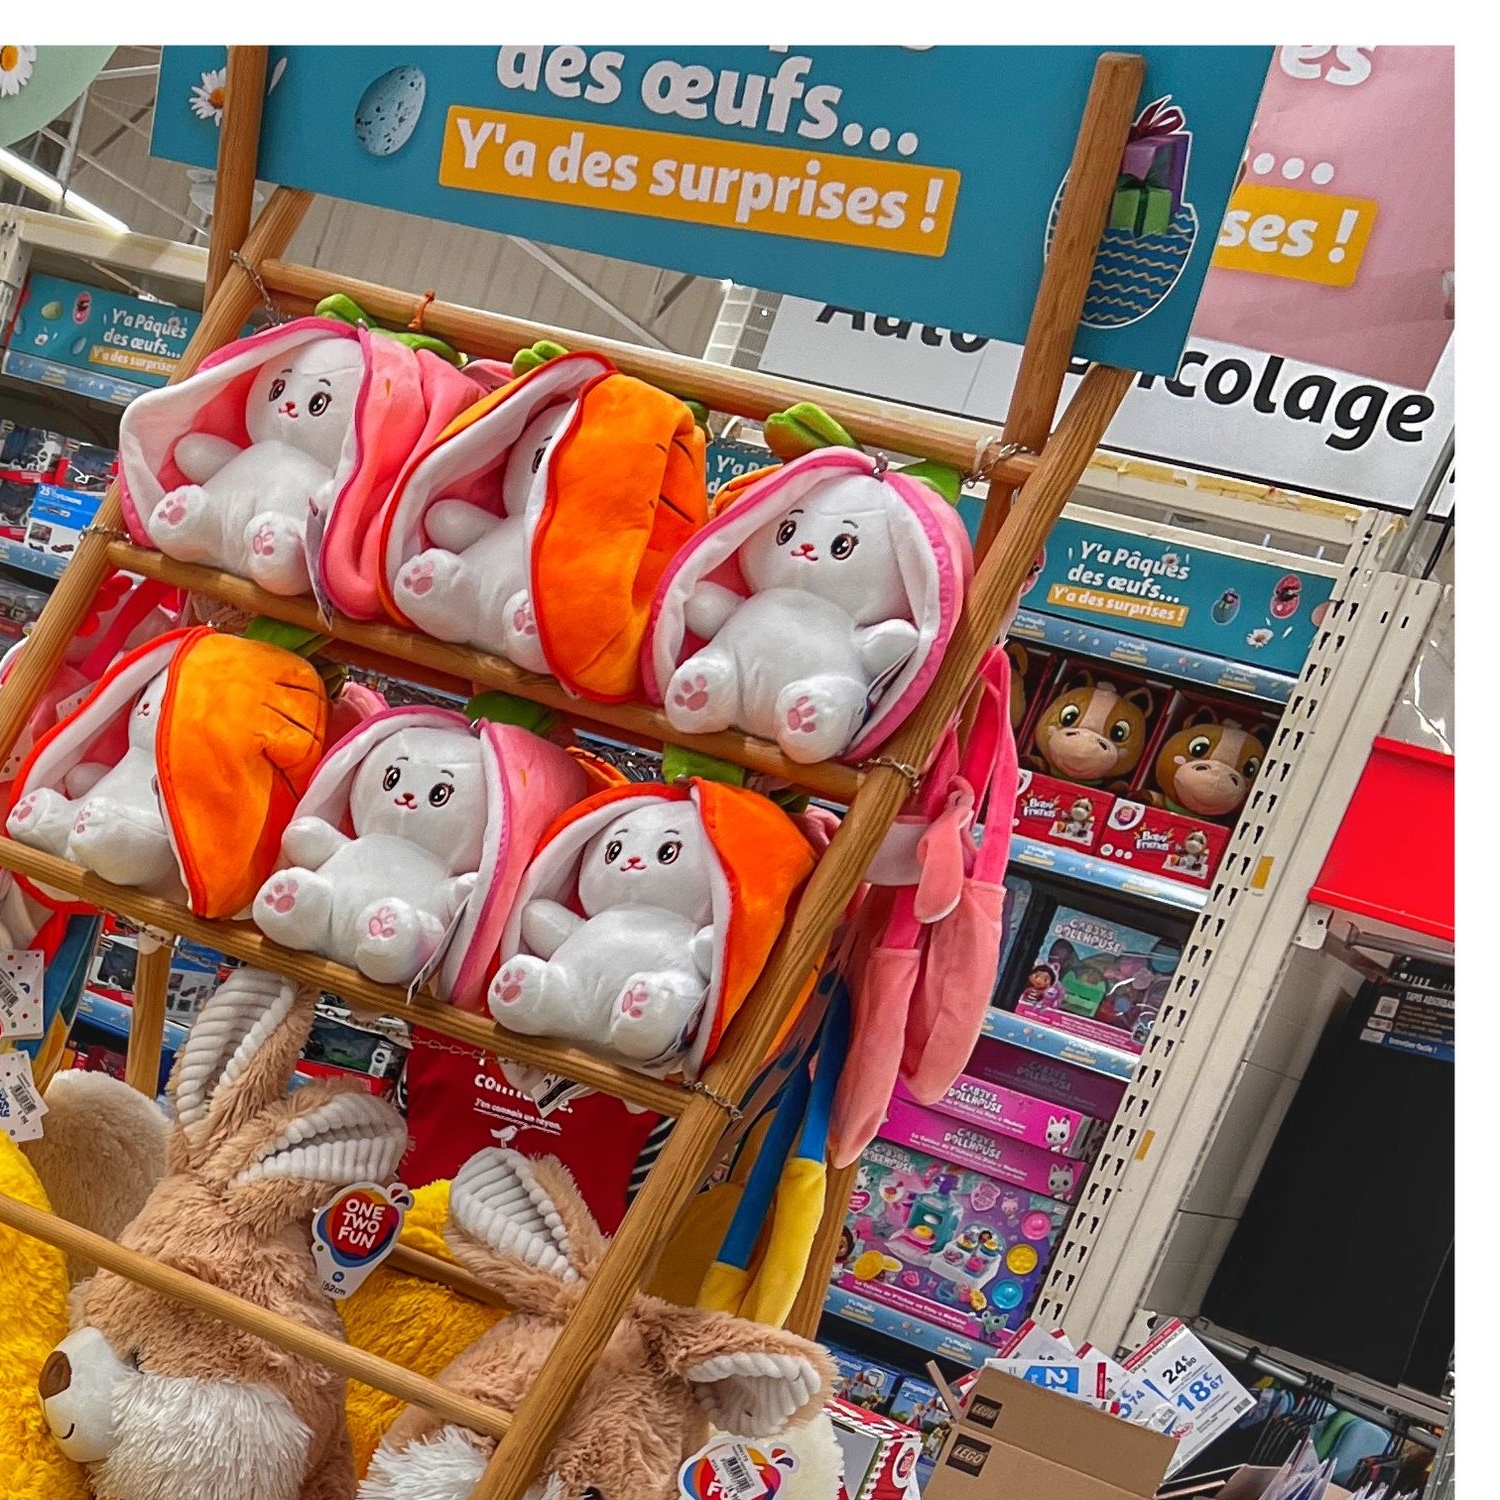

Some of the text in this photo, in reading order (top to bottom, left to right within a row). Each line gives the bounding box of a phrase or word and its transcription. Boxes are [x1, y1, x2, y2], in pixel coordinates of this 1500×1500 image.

[497, 45, 624, 104] des
[457, 119, 537, 178] Y'a
[548, 132, 638, 192] des
[650, 160, 908, 229] surprises
[103, 328, 128, 346] des
[1080, 540, 1111, 563] Y'a
[1068, 563, 1103, 587] des
[1078, 589, 1104, 607] des
[1107, 597, 1176, 623] surprises
[346, 1198, 386, 1220] ONE
[343, 1211, 380, 1233] TWO
[338, 1226, 376, 1249] FUN
[954, 1445, 984, 1463] LEGO
